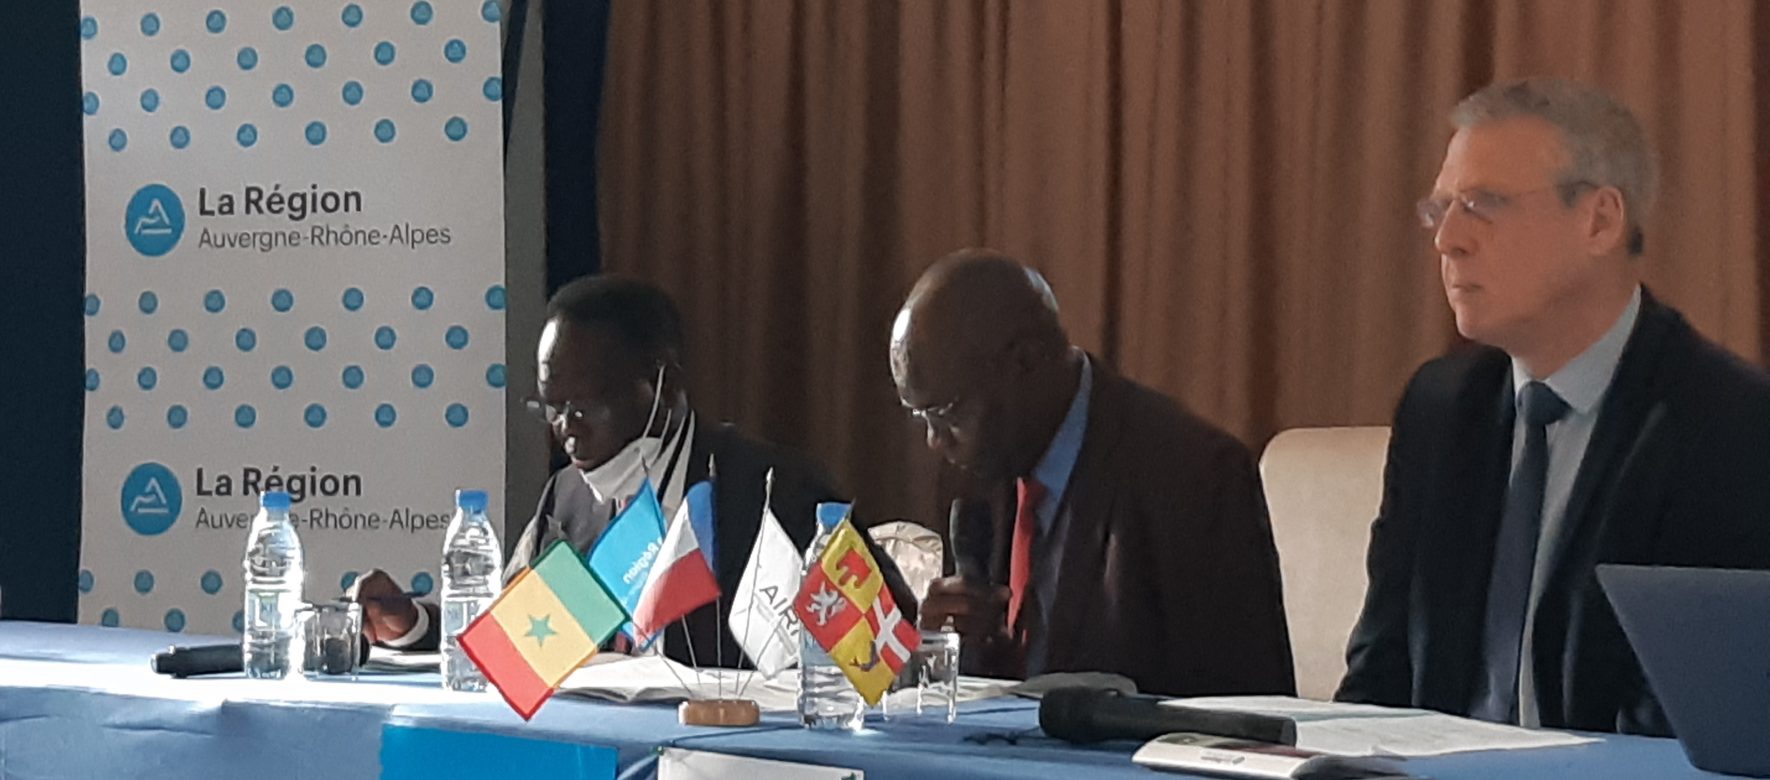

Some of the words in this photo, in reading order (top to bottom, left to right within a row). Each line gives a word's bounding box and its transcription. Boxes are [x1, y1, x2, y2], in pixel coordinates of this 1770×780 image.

[199, 187, 235, 216] La
[245, 184, 362, 222] Région
[199, 223, 453, 253] Auvergne-Rhône-Alpes
[196, 467, 233, 497] La
[243, 465, 362, 503] Région
[195, 507, 451, 534] Auvere-Rhône-Alpes
[759, 585, 800, 636] AIR
